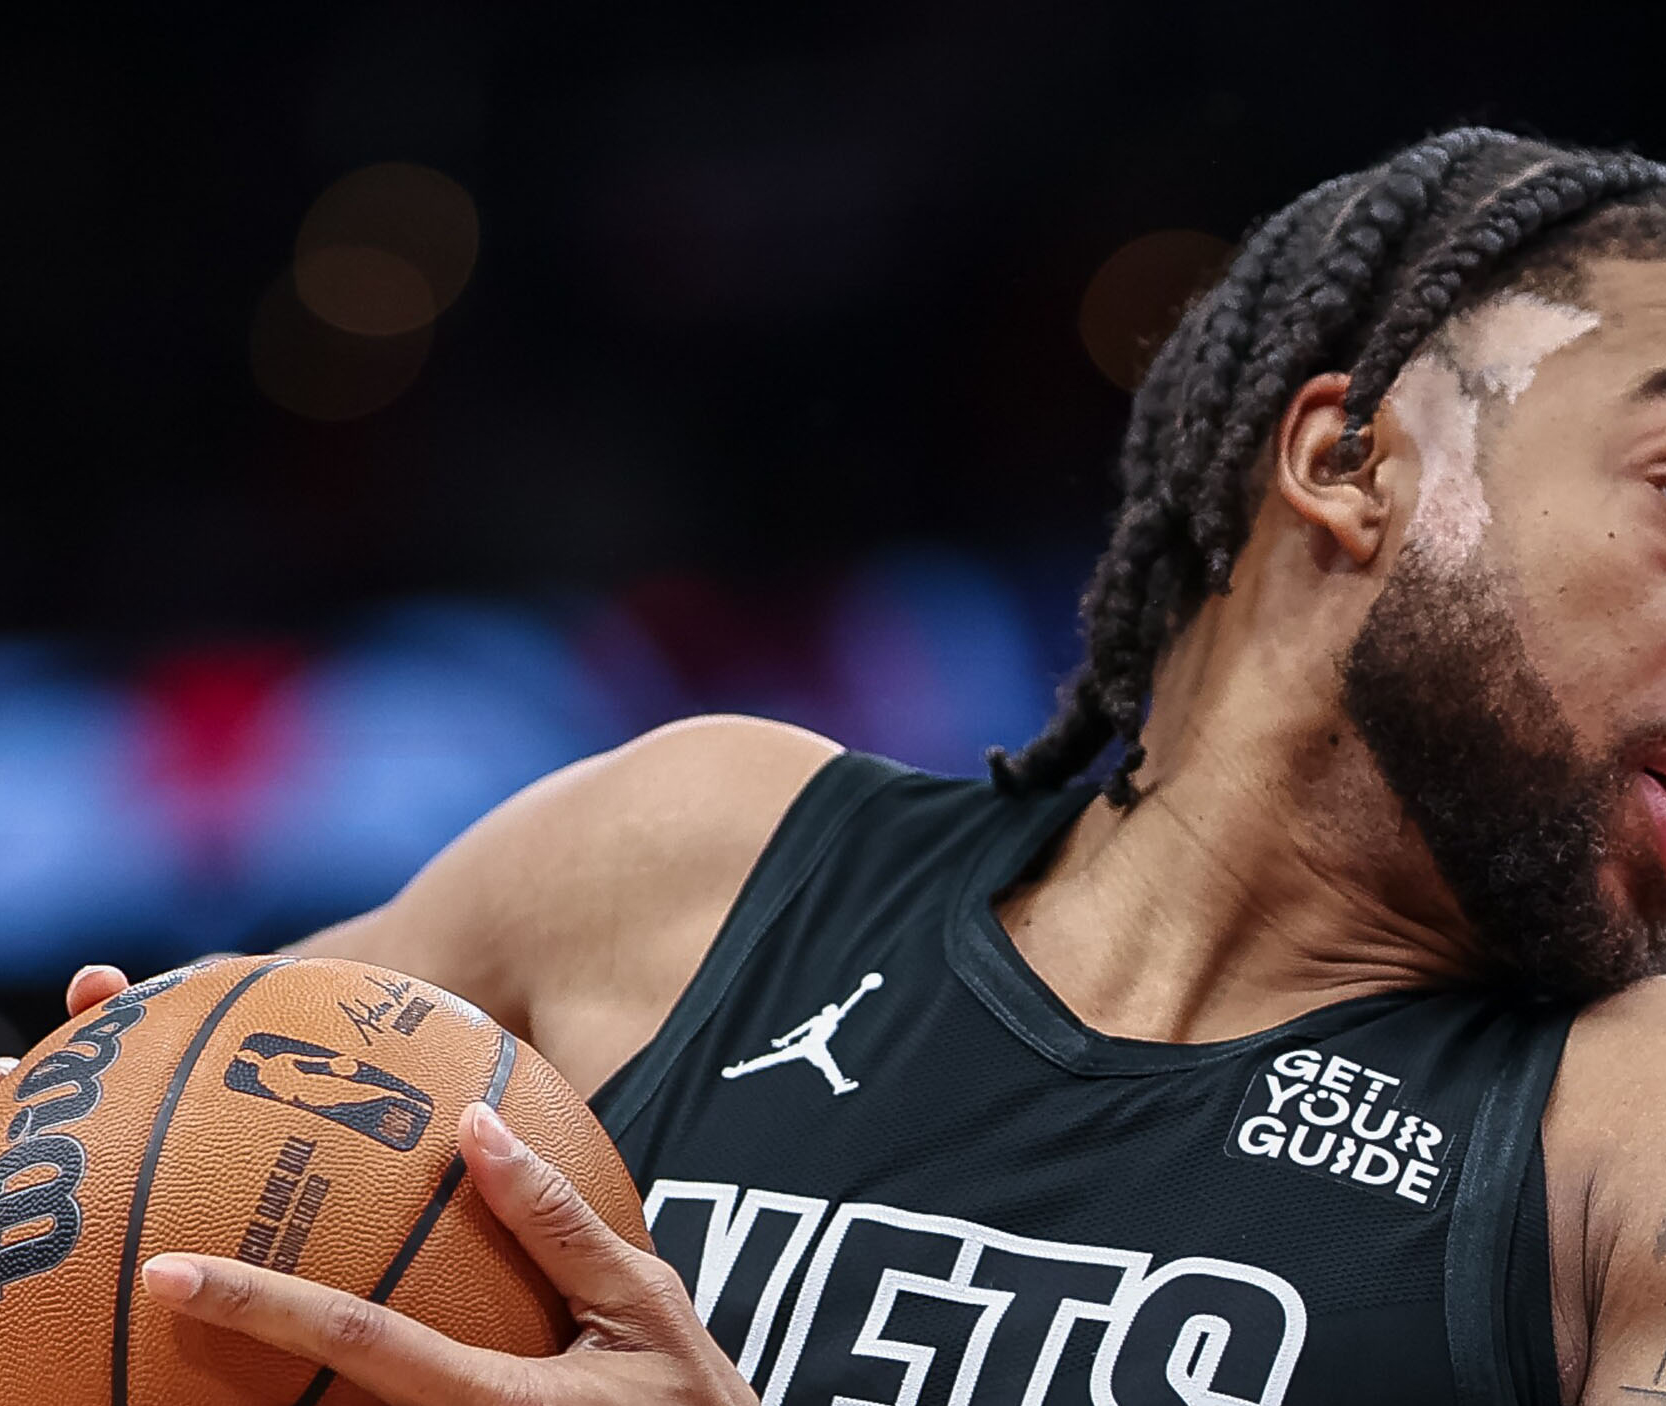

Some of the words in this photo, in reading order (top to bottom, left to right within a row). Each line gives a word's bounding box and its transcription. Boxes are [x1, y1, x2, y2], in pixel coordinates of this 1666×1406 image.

[1272, 1049, 1401, 1103] GET
[1265, 1073, 1444, 1162] YOUR
[275, 1135, 317, 1176] BALL
[1237, 1115, 1441, 1205] GUIDE
[254, 1170, 299, 1222] GAME
